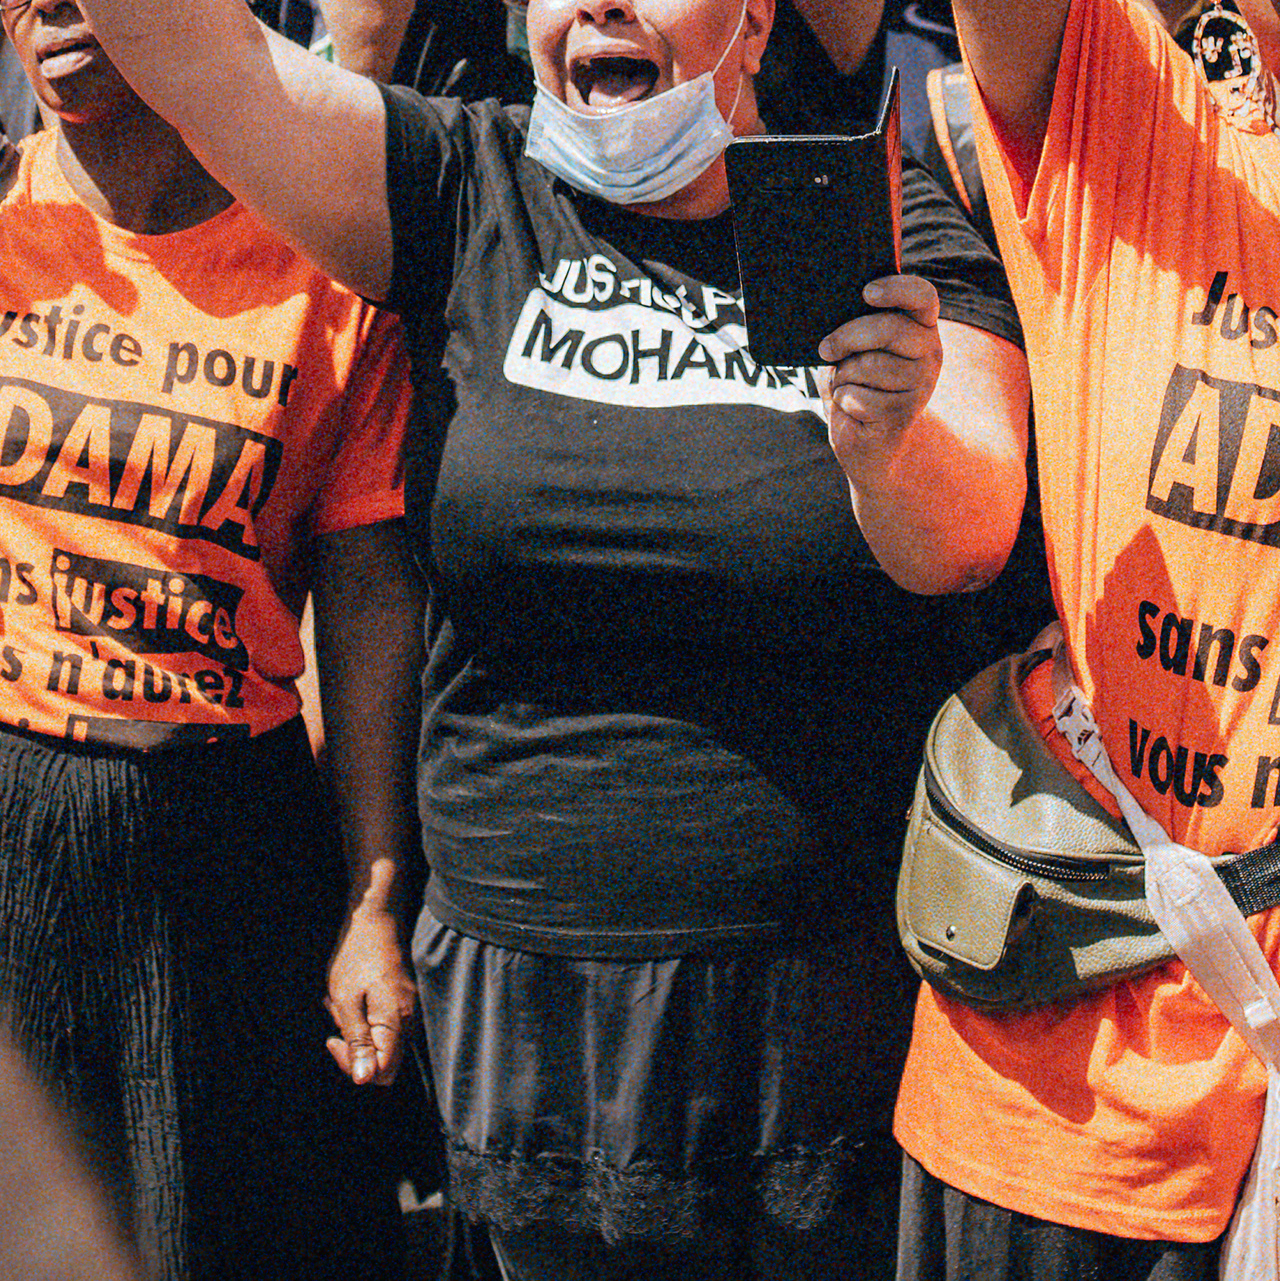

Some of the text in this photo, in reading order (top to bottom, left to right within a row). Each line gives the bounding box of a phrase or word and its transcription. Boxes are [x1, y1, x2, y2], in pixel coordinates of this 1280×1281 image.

[162, 337, 299, 408] pour
[53, 554, 239, 649] justice
[1136, 600, 1269, 692] sans
[1129, 717, 1229, 808] vous
